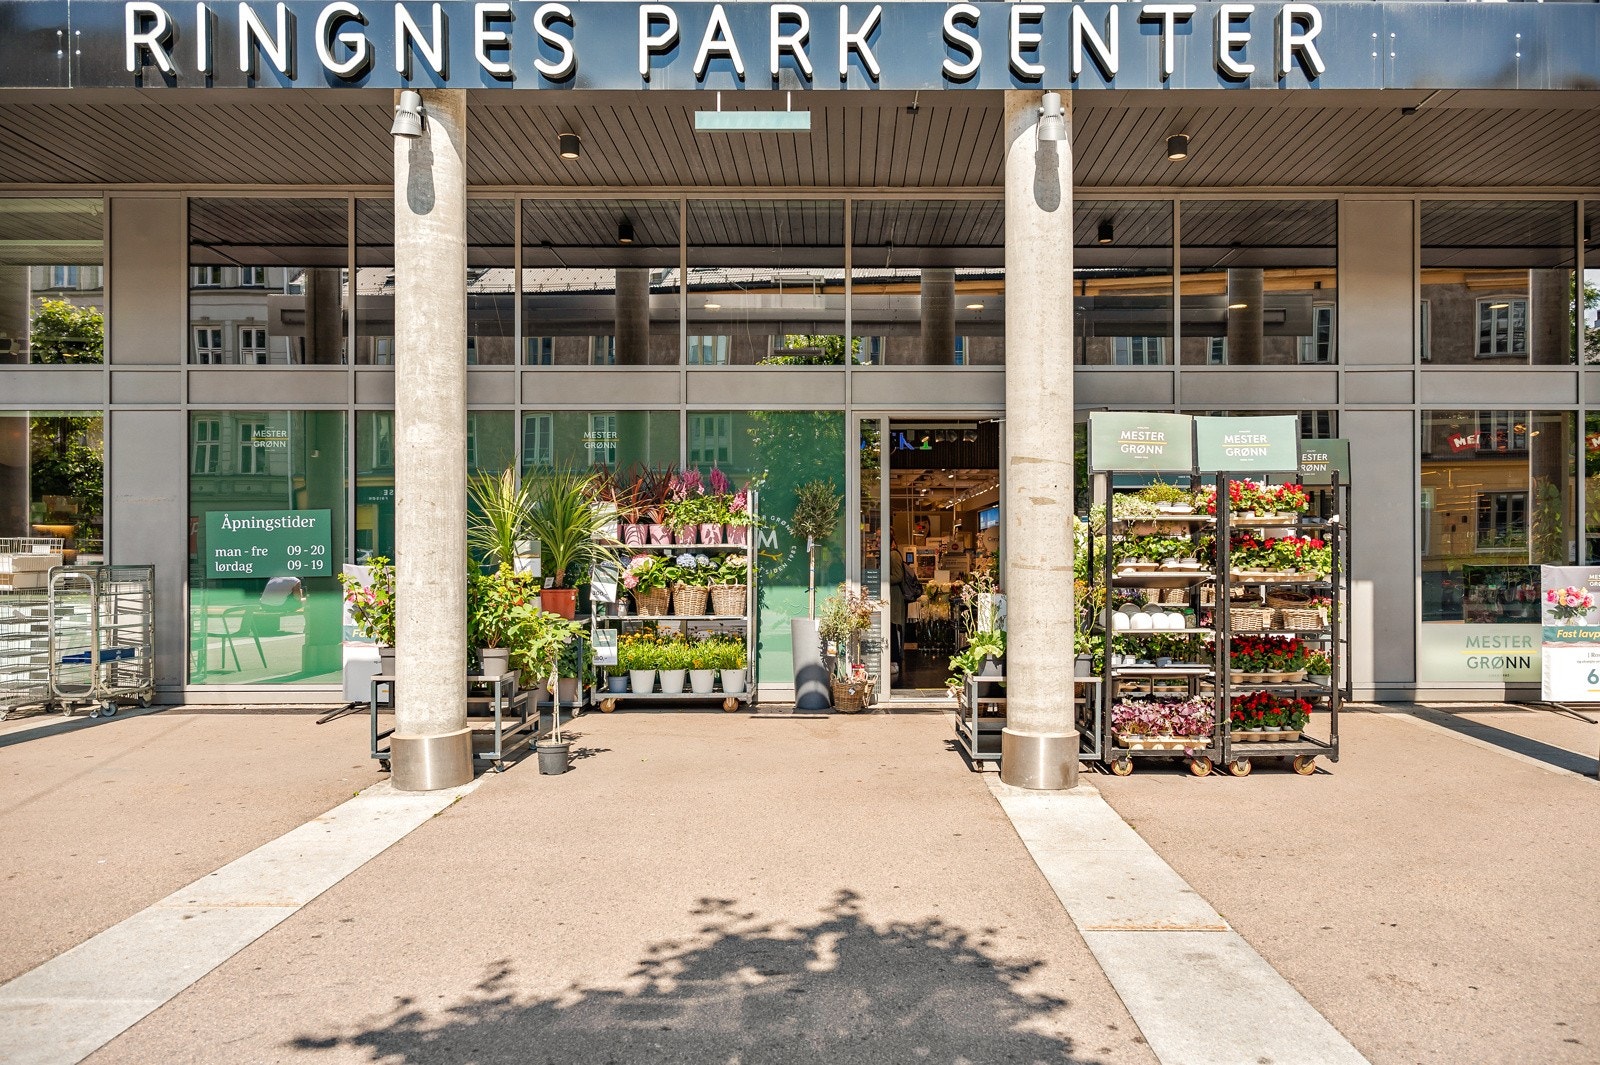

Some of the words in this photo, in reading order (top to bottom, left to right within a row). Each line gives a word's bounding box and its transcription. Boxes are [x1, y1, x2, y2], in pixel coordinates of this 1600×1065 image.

[125, 1, 576, 77] RINGNES
[638, 4, 883, 78] PARK
[942, 3, 1326, 79] SENTER
[583, 431, 618, 439] MESTER
[1121, 430, 1165, 441] MESTER
[1224, 434, 1267, 444] MESTER
[1121, 444, 1163, 454] GRØNN
[1225, 447, 1267, 457] GRØNN
[1301, 453, 1328, 461] ESTER
[1300, 464, 1327, 472] RØNN
[221, 513, 316, 532] Åpningstider
[215, 548, 241, 557] man
[251, 546, 268, 556] fre
[287, 545, 301, 555] 09
[310, 545, 325, 555] 20
[215, 562, 253, 573] lørdag
[287, 560, 301, 570] 09
[311, 560, 324, 570] 19
[1556, 629, 1577, 638] Fast
[1465, 635, 1533, 649] MESTER
[1466, 656, 1531, 669] GRØNN
[1587, 668, 1600, 685] 6
